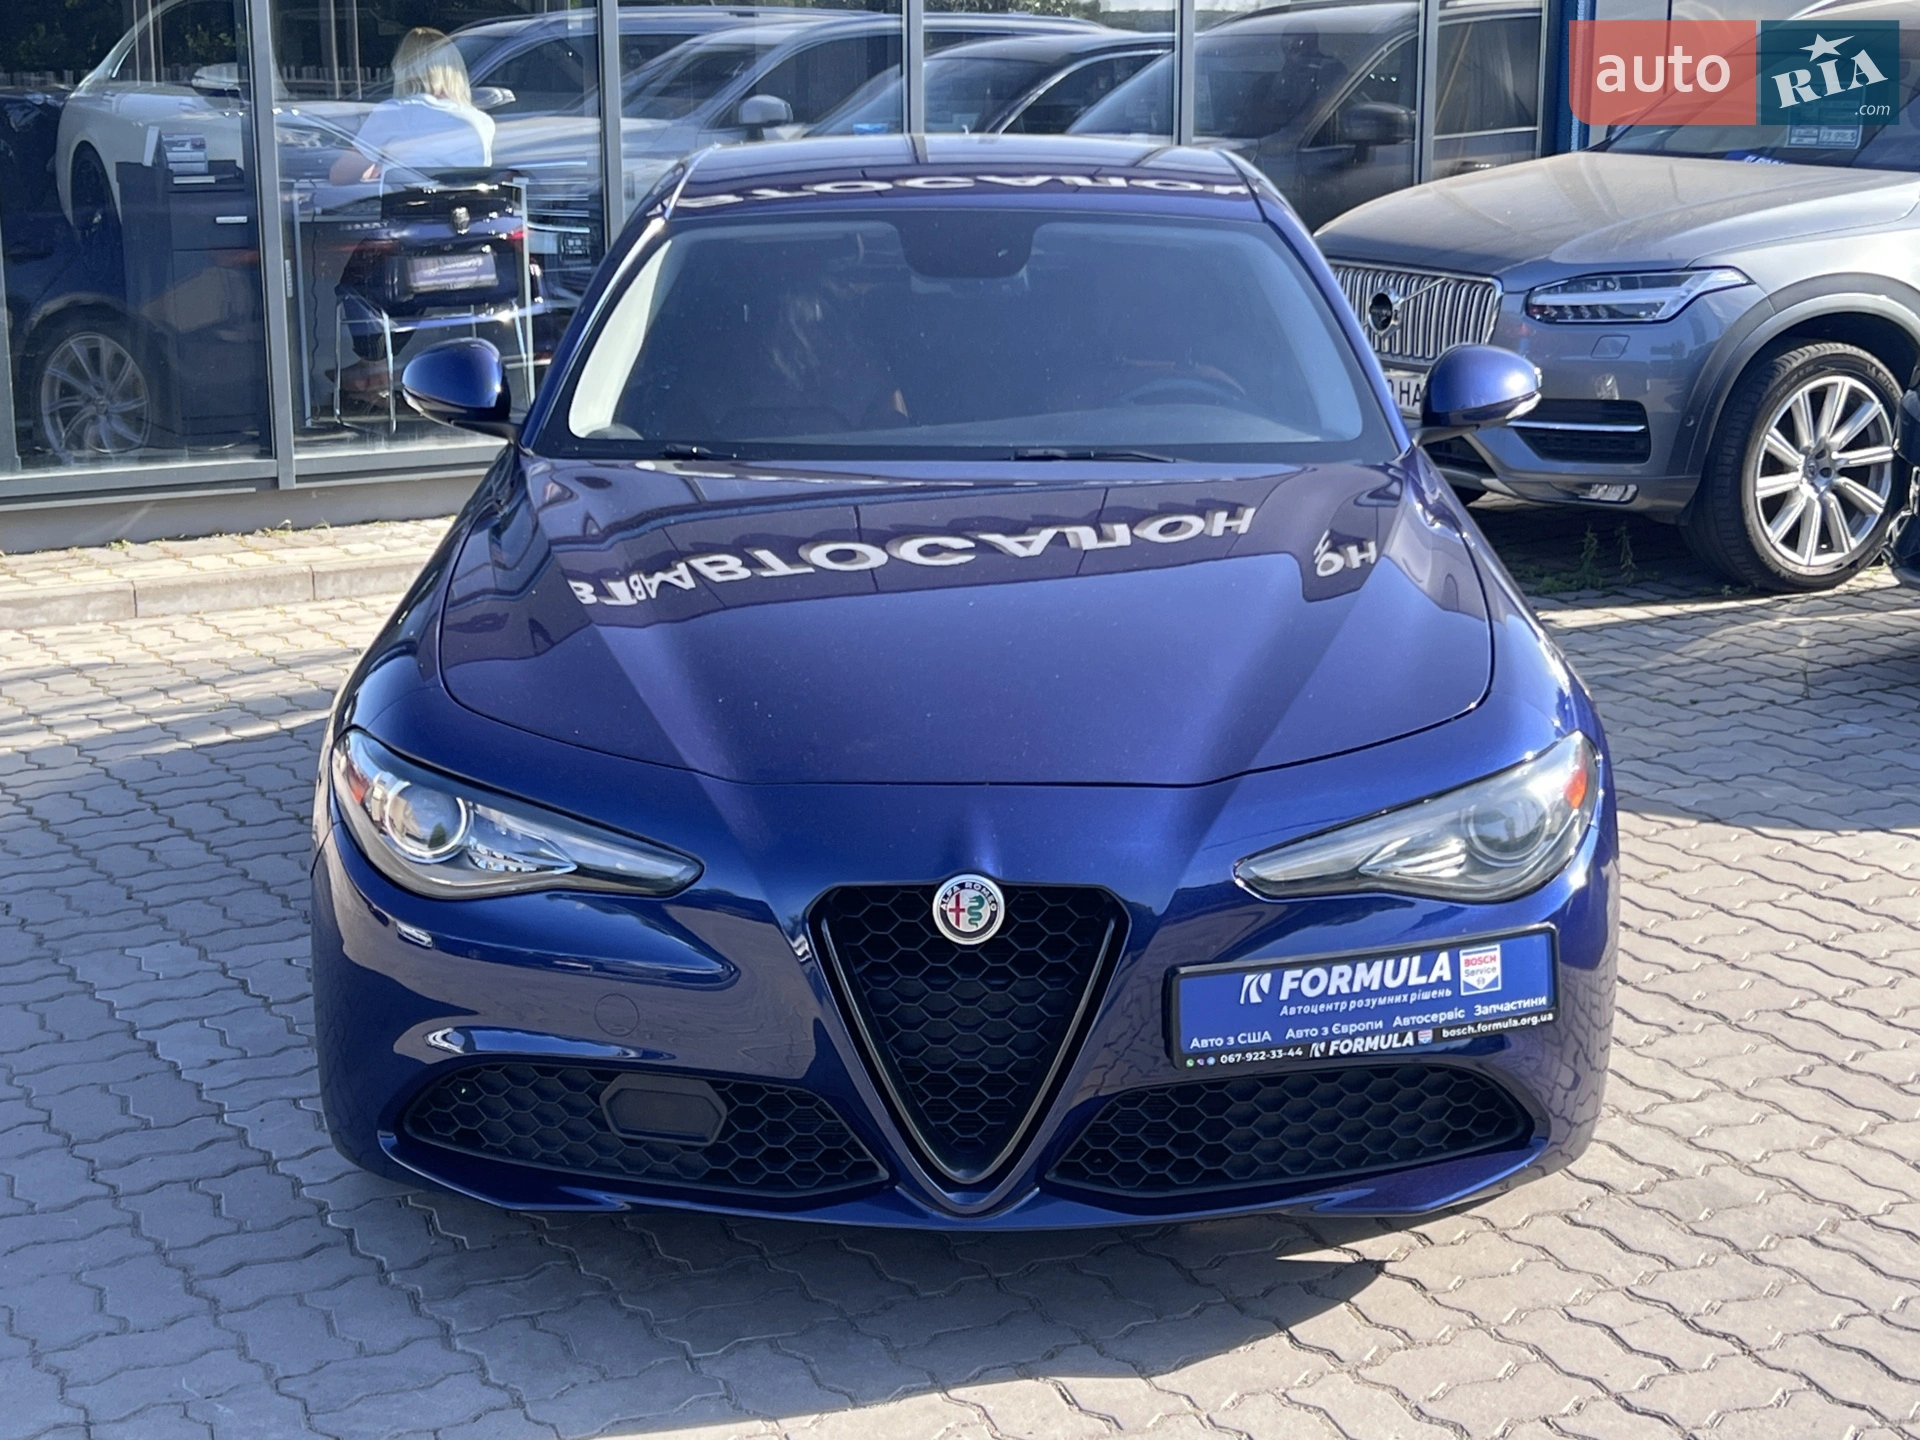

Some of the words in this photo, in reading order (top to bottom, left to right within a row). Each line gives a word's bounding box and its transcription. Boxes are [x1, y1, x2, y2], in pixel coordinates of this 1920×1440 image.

[940, 885, 961, 911] ALFA
[965, 882, 997, 911] ROMEO
[1279, 952, 1452, 1000] FORMULA
[1463, 954, 1497, 968] BOSCH
[1463, 966, 1498, 978] Service
[1279, 1001, 1347, 1017] Автоцентр
[1348, 994, 1408, 1012] розумних
[1409, 987, 1453, 1004] рішень
[1189, 1037, 1224, 1050] Авто
[1226, 1036, 1235, 1046] з
[1237, 1030, 1272, 1045] США
[1285, 1028, 1319, 1041] Авто
[1321, 1026, 1329, 1036] з
[1331, 1020, 1383, 1036] Європи
[1392, 1006, 1466, 1028] Автосервіс
[1473, 995, 1547, 1017] Запчастини
[1220, 1047, 1303, 1064] 067-922-33-44
[1329, 1031, 1414, 1056] FORMULA
[1441, 1011, 1554, 1039] bosch.formula.org.ua
